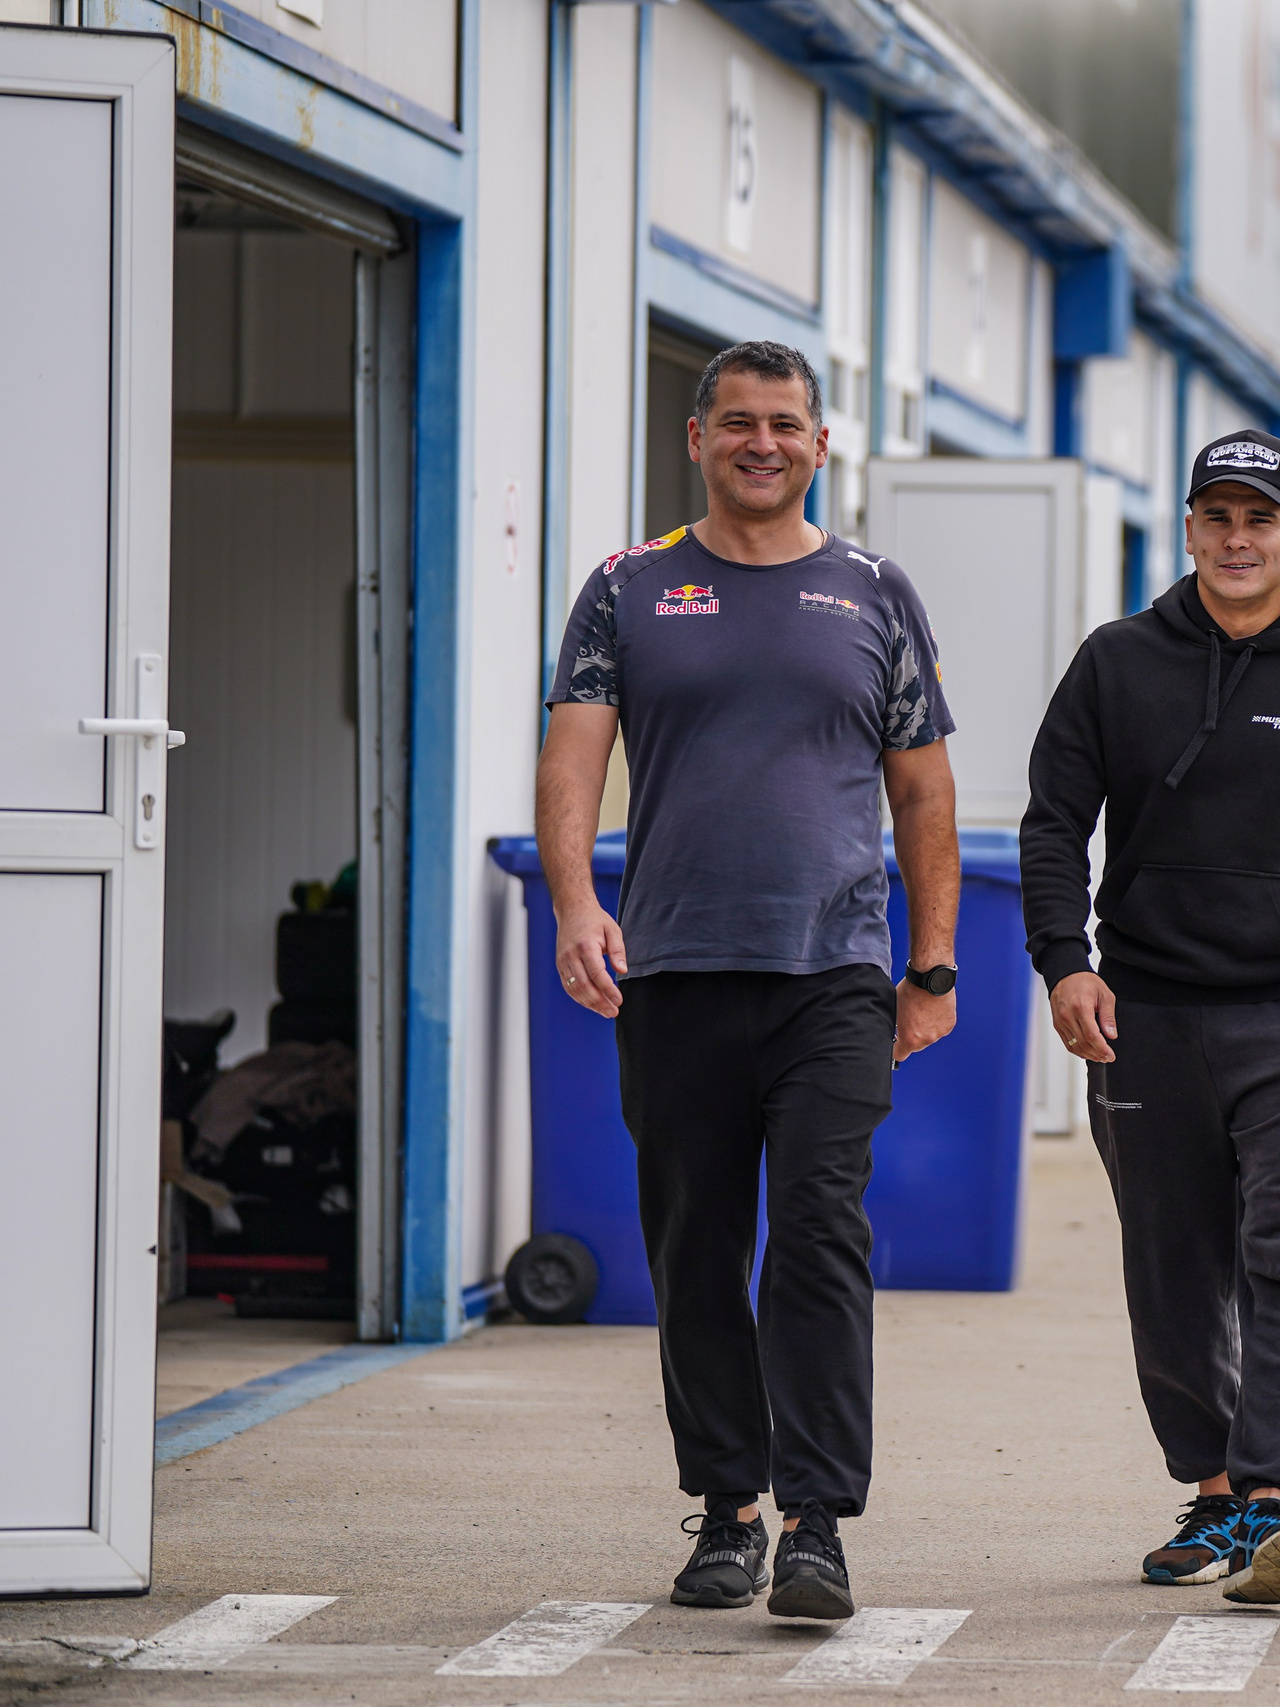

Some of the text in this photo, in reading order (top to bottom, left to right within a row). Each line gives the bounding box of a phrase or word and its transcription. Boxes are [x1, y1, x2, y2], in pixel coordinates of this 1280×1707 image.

[1211, 448, 1254, 461] MUSTANG
[1254, 450, 1276, 464] CLUB
[656, 599, 719, 615] Red Bull
[799, 600, 860, 617] RACING
[697, 1550, 746, 1567] PUMA
